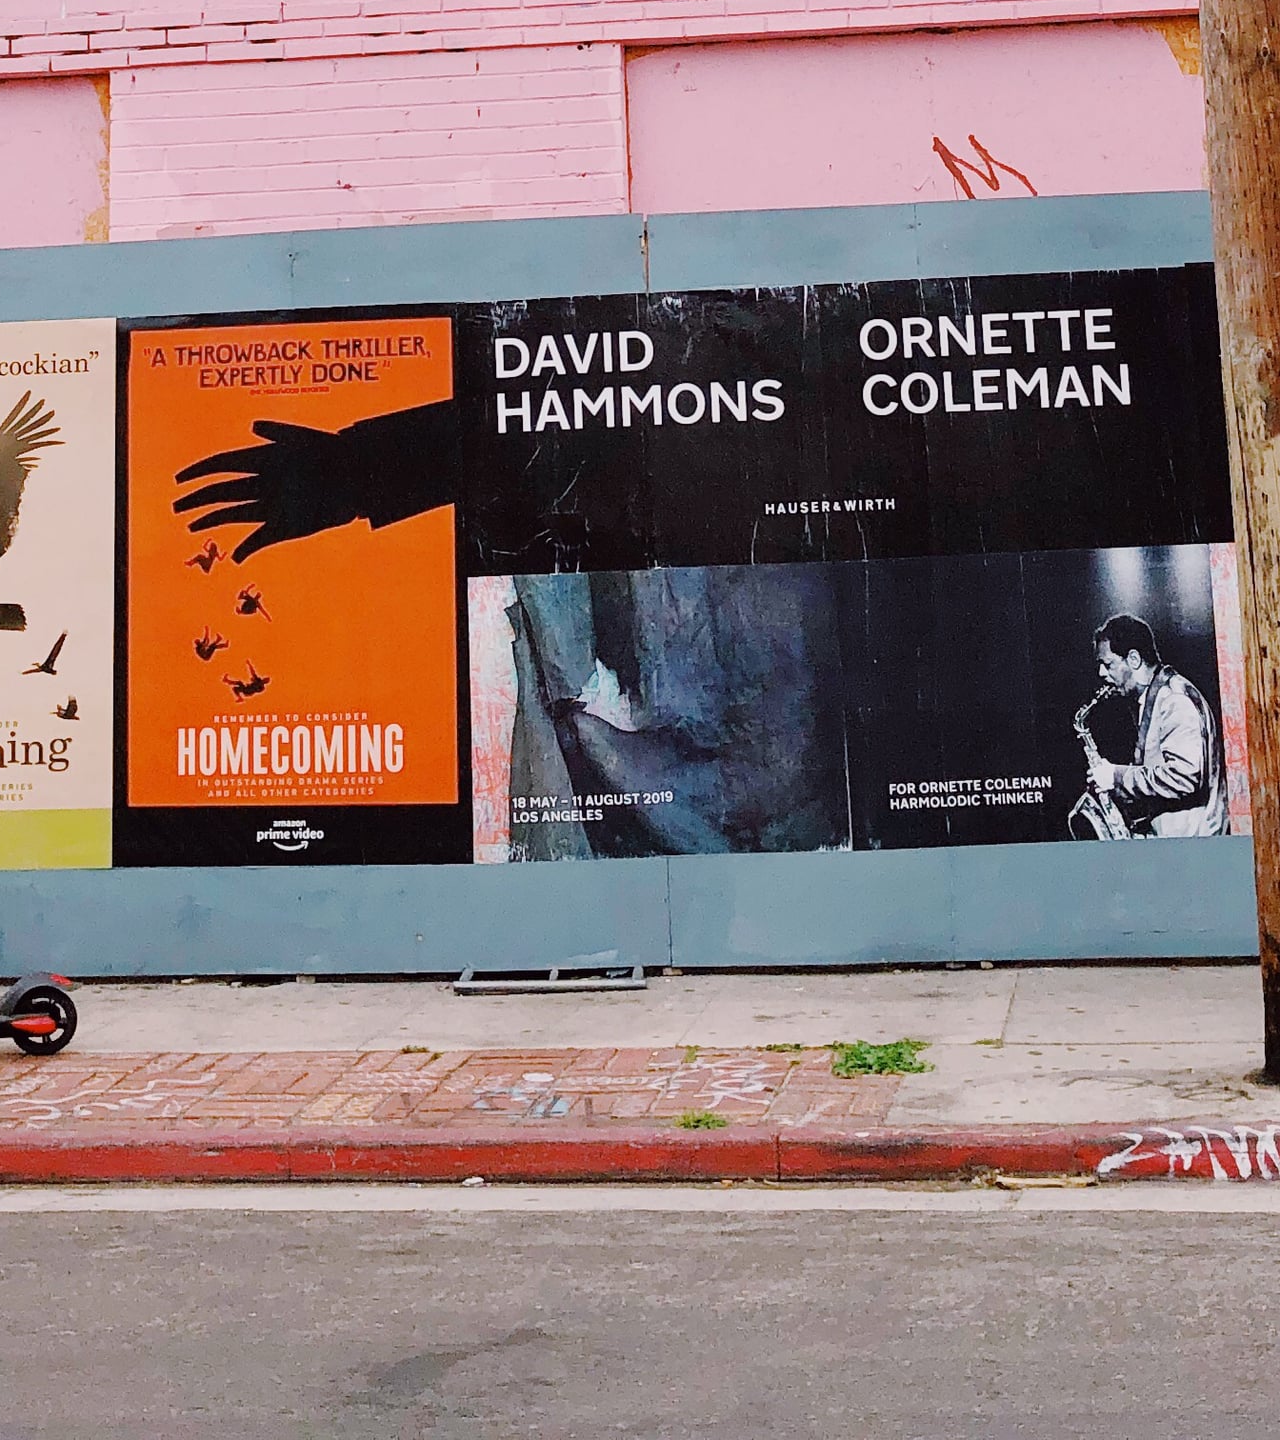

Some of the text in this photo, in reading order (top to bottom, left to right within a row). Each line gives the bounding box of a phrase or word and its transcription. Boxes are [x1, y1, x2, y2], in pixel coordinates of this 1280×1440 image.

[859, 309, 1116, 360] ORNETTE
[174, 340, 312, 367] THROWBACK
[320, 336, 431, 360] THRILLER,
[494, 330, 654, 379] DAVID
[199, 364, 302, 389] EXPERTLY
[862, 363, 1132, 416] COLEMAN
[496, 378, 785, 434] HAMMONS
[765, 497, 896, 515] HAUSER&WIRTH
[214, 712, 368, 723] REMEMBER TO CONSIDER
[178, 723, 404, 776] HOMECOMING
[198, 776, 384, 787] IN OUTSTANDING DRAMA SERIES
[889, 776, 1052, 796] FOR ORNETTE COLEMAN
[208, 787, 374, 797] AND ALL OTHER CATEGORIES
[512, 797, 526, 809] 18
[530, 796, 558, 809] MAY
[572, 795, 582, 807] 11
[585, 793, 640, 806] AUGUST
[642, 791, 674, 804] 2019
[890, 791, 1044, 810] HARMOLODIC THINKER
[273, 819, 307, 827] amazon
[513, 809, 604, 824] LOS ANGELES
[256, 827, 324, 842] prime video
